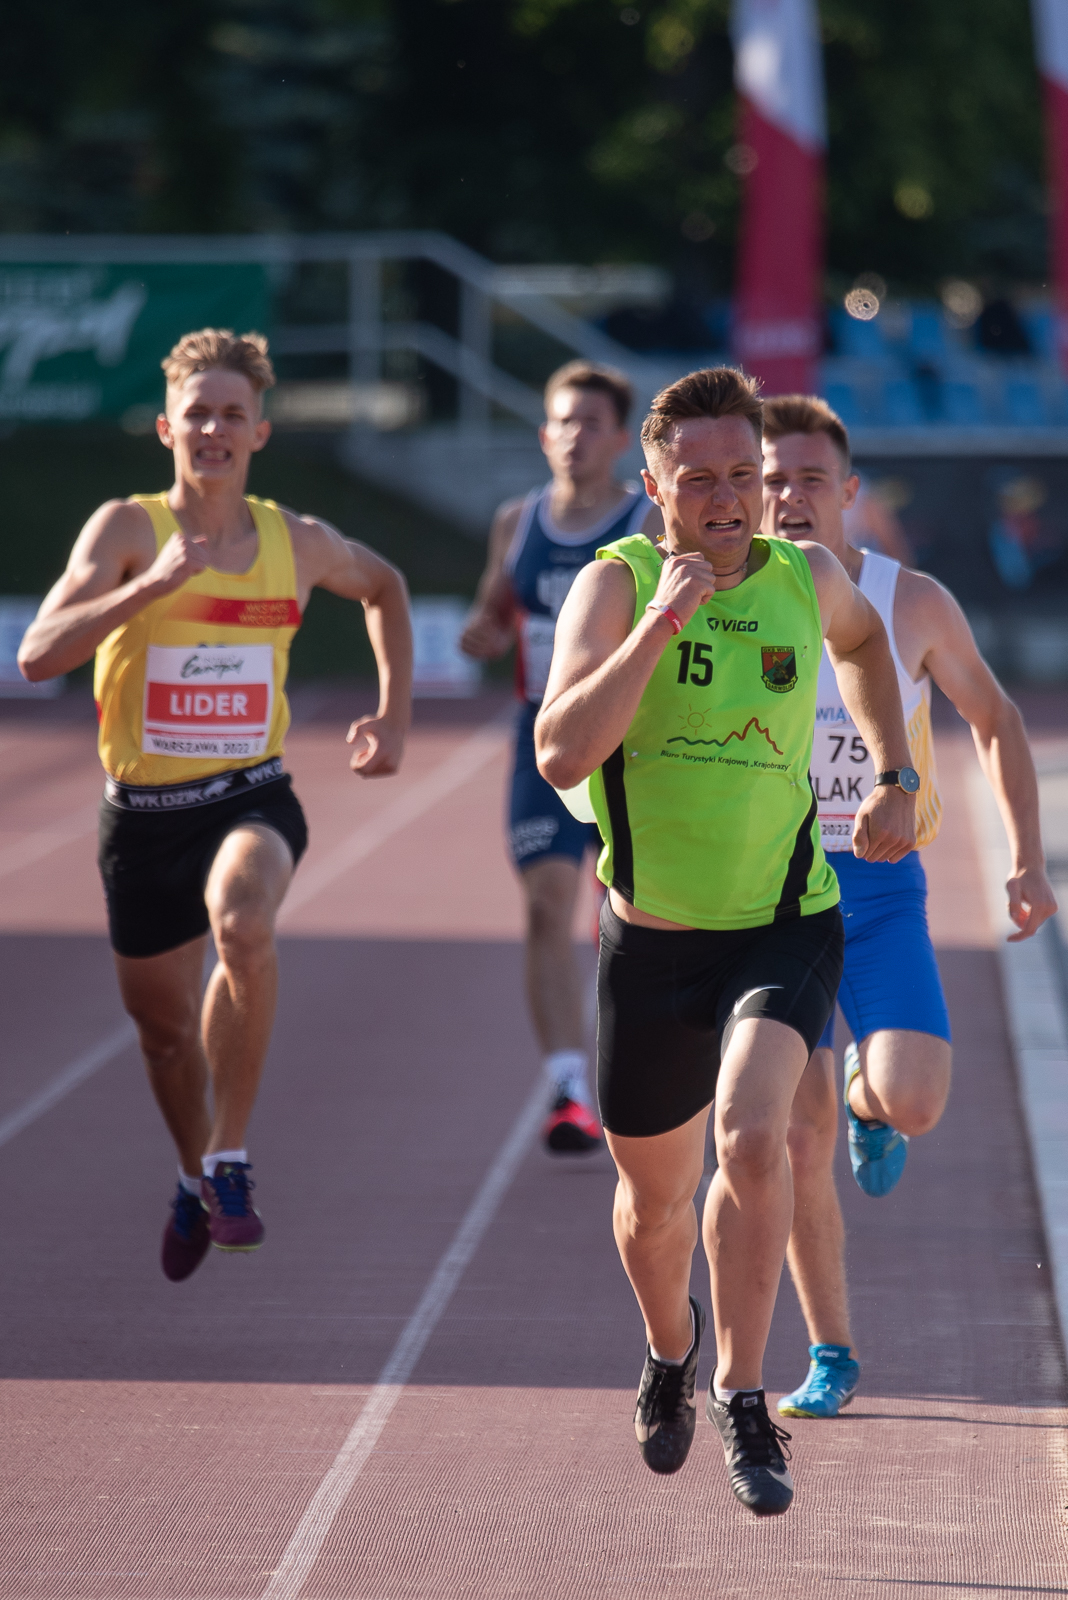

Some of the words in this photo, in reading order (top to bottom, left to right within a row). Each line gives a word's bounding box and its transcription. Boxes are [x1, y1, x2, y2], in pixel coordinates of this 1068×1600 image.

[677, 640, 713, 687] 15
[169, 692, 248, 716] LIDER
[151, 737, 220, 754] WARSZAWA
[223, 743, 250, 754] 2022
[828, 735, 868, 763] 75
[660, 750, 679, 758] Biuro
[682, 753, 716, 764] Turystyki
[718, 757, 749, 767] Krajowej
[811, 777, 863, 802] LAK
[821, 824, 851, 836] 2022
